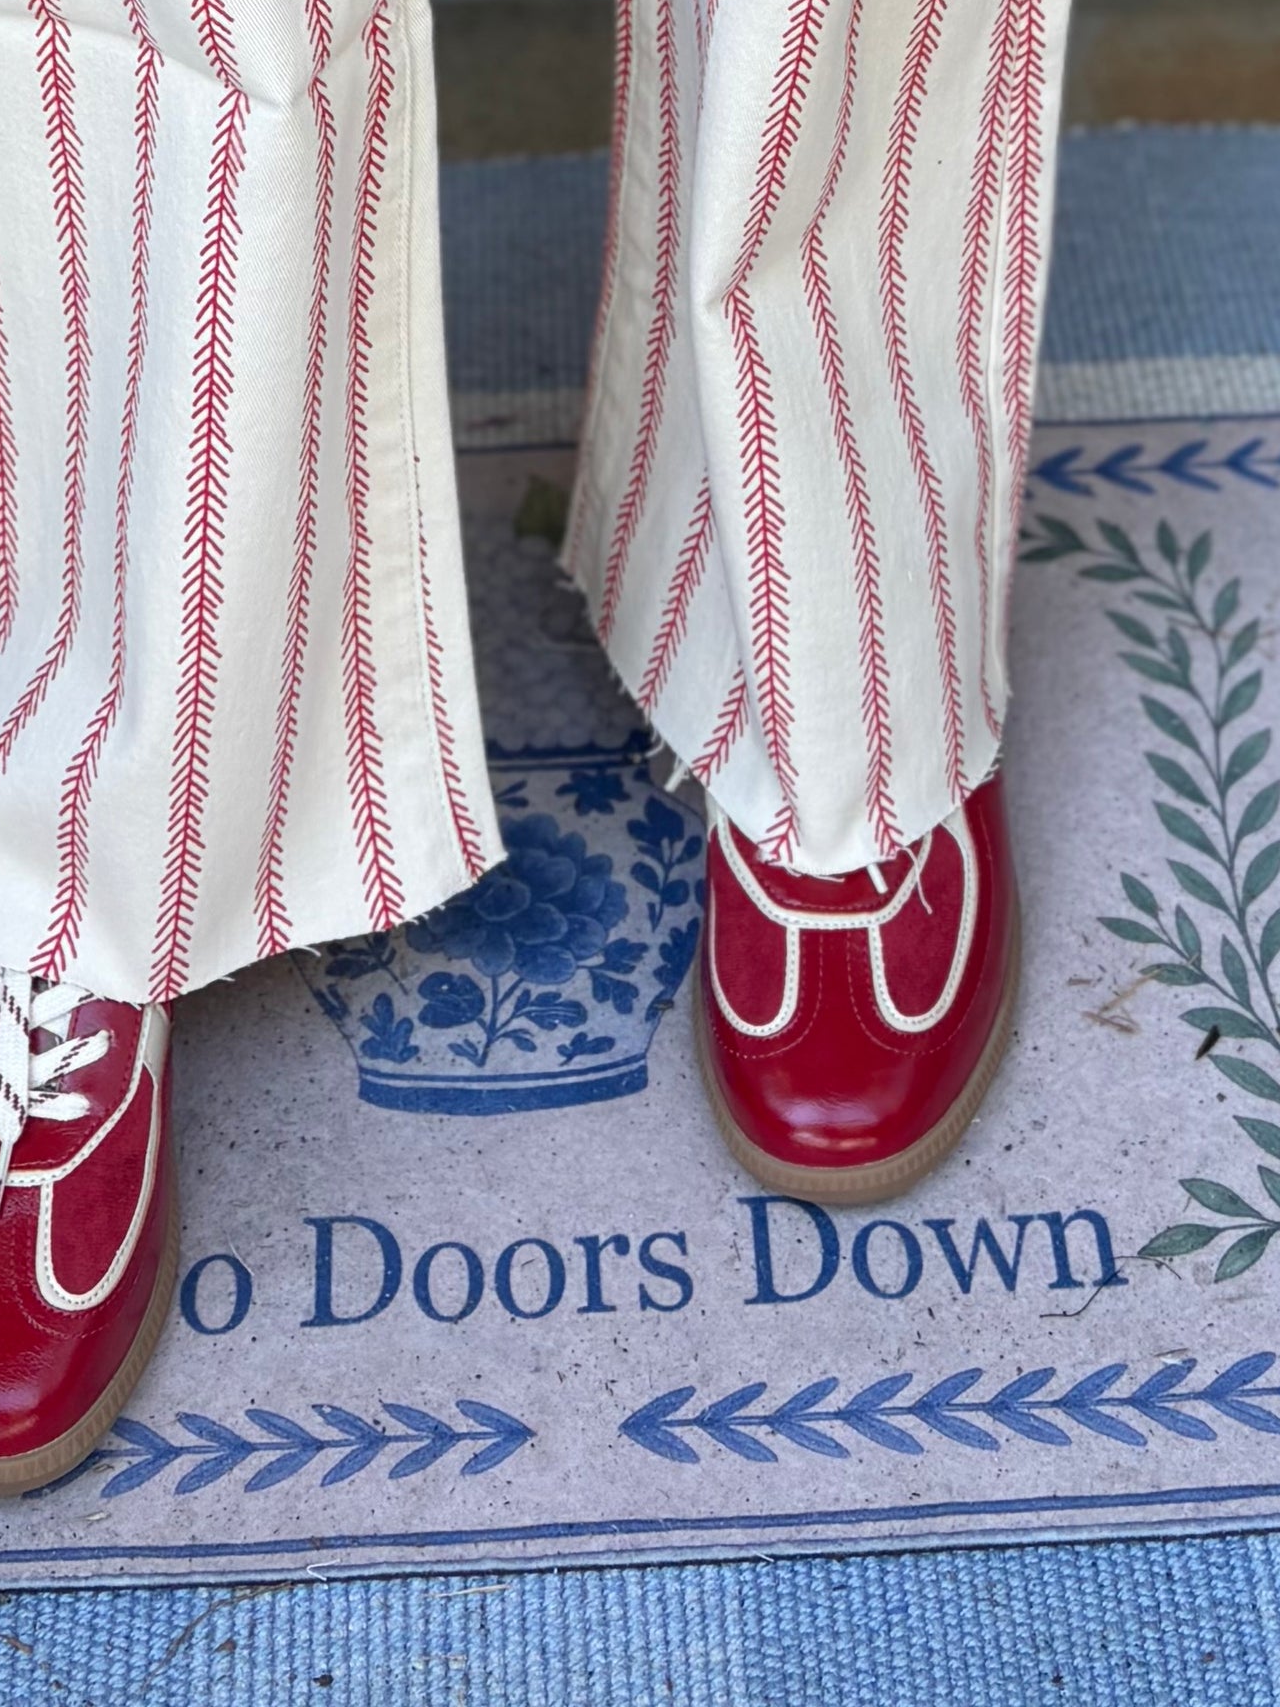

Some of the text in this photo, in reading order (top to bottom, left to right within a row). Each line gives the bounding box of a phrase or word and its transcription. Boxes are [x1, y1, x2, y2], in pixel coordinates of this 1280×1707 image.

[179, 1194, 1130, 1336] o Doors Down
